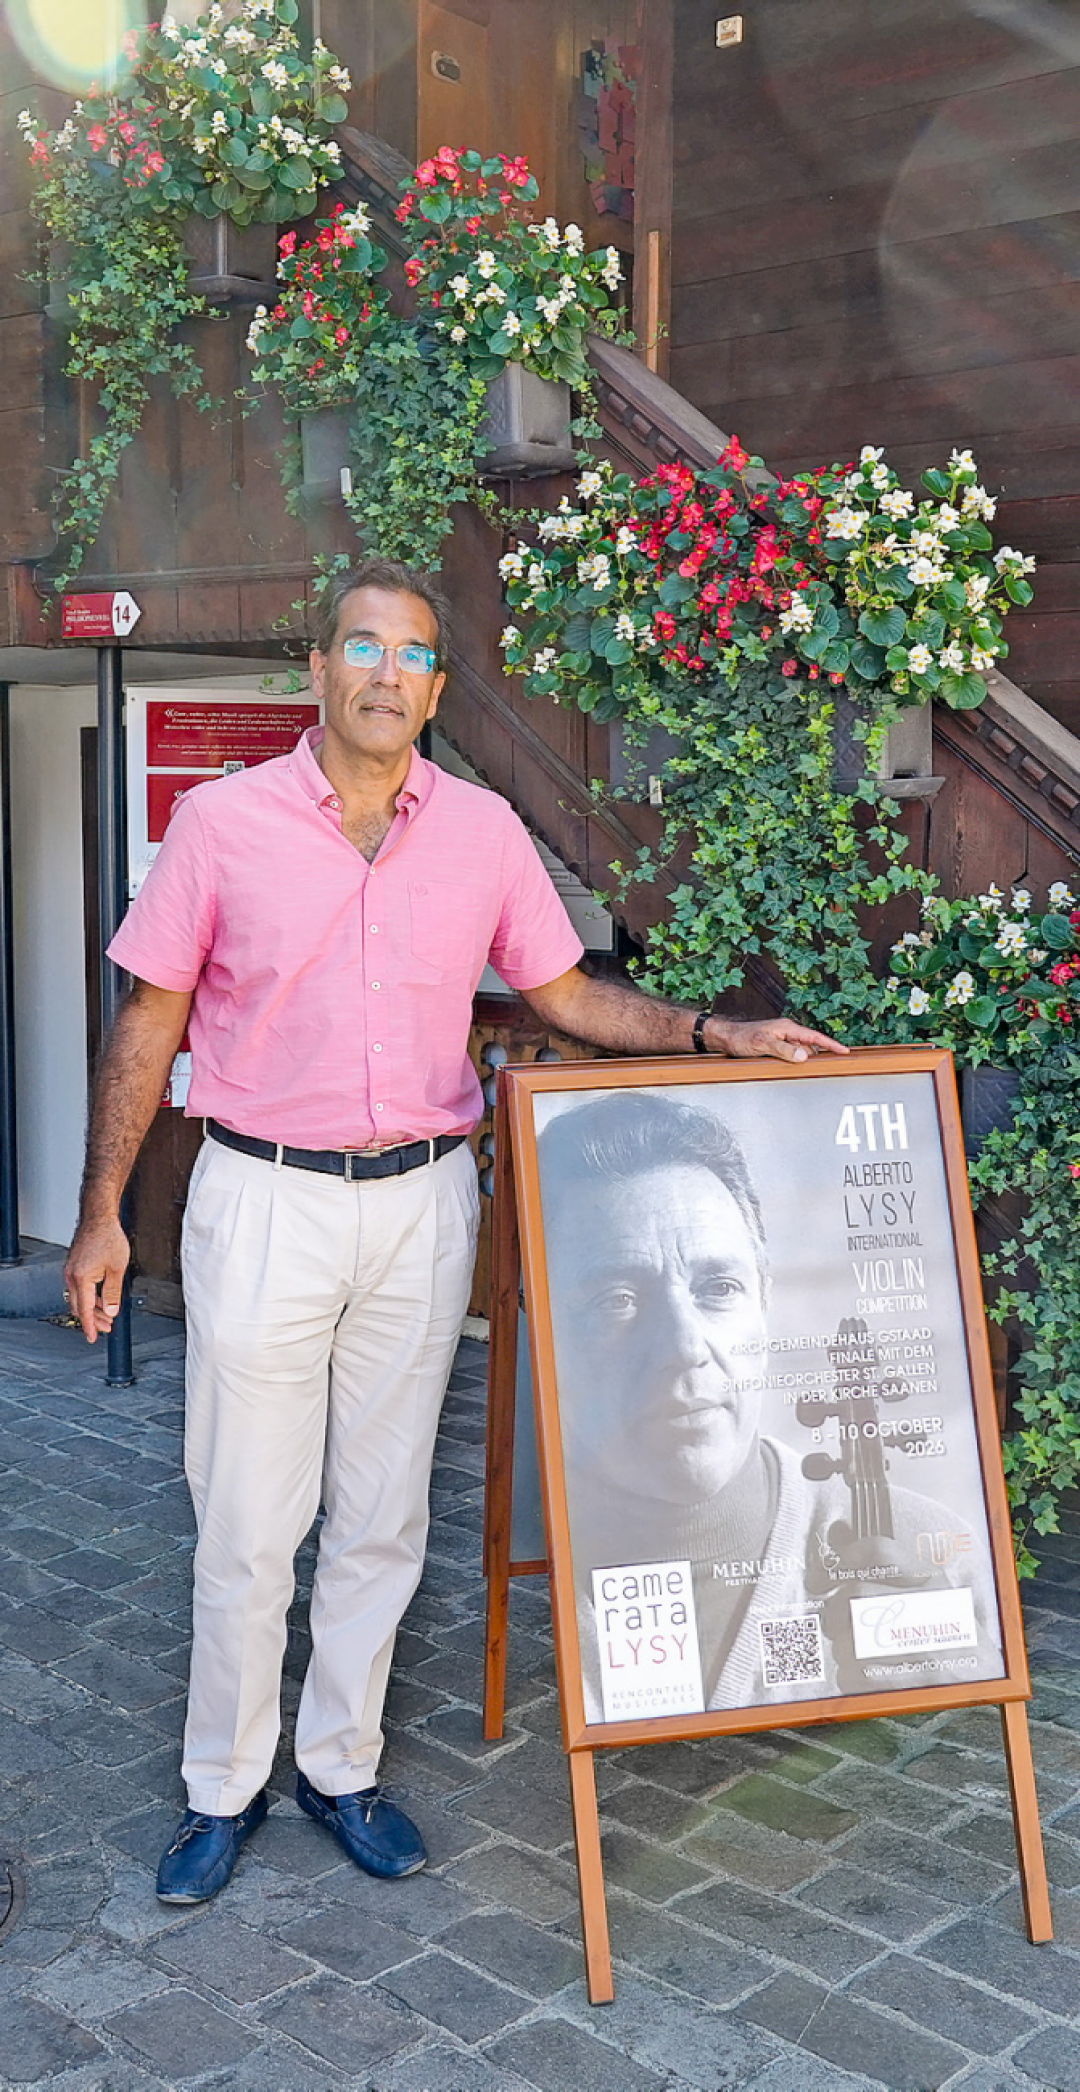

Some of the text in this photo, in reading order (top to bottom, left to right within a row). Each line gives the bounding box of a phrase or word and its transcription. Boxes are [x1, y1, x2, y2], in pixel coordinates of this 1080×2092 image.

[114, 605, 131, 623] 14
[835, 1101, 909, 1153] 4TH
[843, 1161, 914, 1188] ALBERTO
[843, 1190, 917, 1229] LYSY
[847, 1232, 924, 1251] INTERNATIONAL
[852, 1256, 926, 1293] VIOLIN
[856, 1294, 928, 1314] COMPETITION
[728, 1326, 932, 1356] KIRCHGEMEINDEHAUS GSTAAD
[829, 1343, 934, 1365] FINALE MIT DEM
[721, 1361, 936, 1393] SINFONIEORCHESTER ST. GALLEN
[783, 1379, 938, 1405] IN DER KIRCHE SAANEN
[812, 1427, 822, 1443] 8
[840, 1423, 859, 1441] 10
[862, 1416, 943, 1439] OCTOBER
[905, 1440, 945, 1458] 2026
[712, 1556, 807, 1580] MENUHIN
[601, 1570, 684, 1601] came
[890, 1621, 961, 1641] MENUHIN
[608, 1633, 688, 1669] LYSY
[612, 1683, 695, 1699] RENCONTRES
[612, 1694, 696, 1710] MUSICALES
